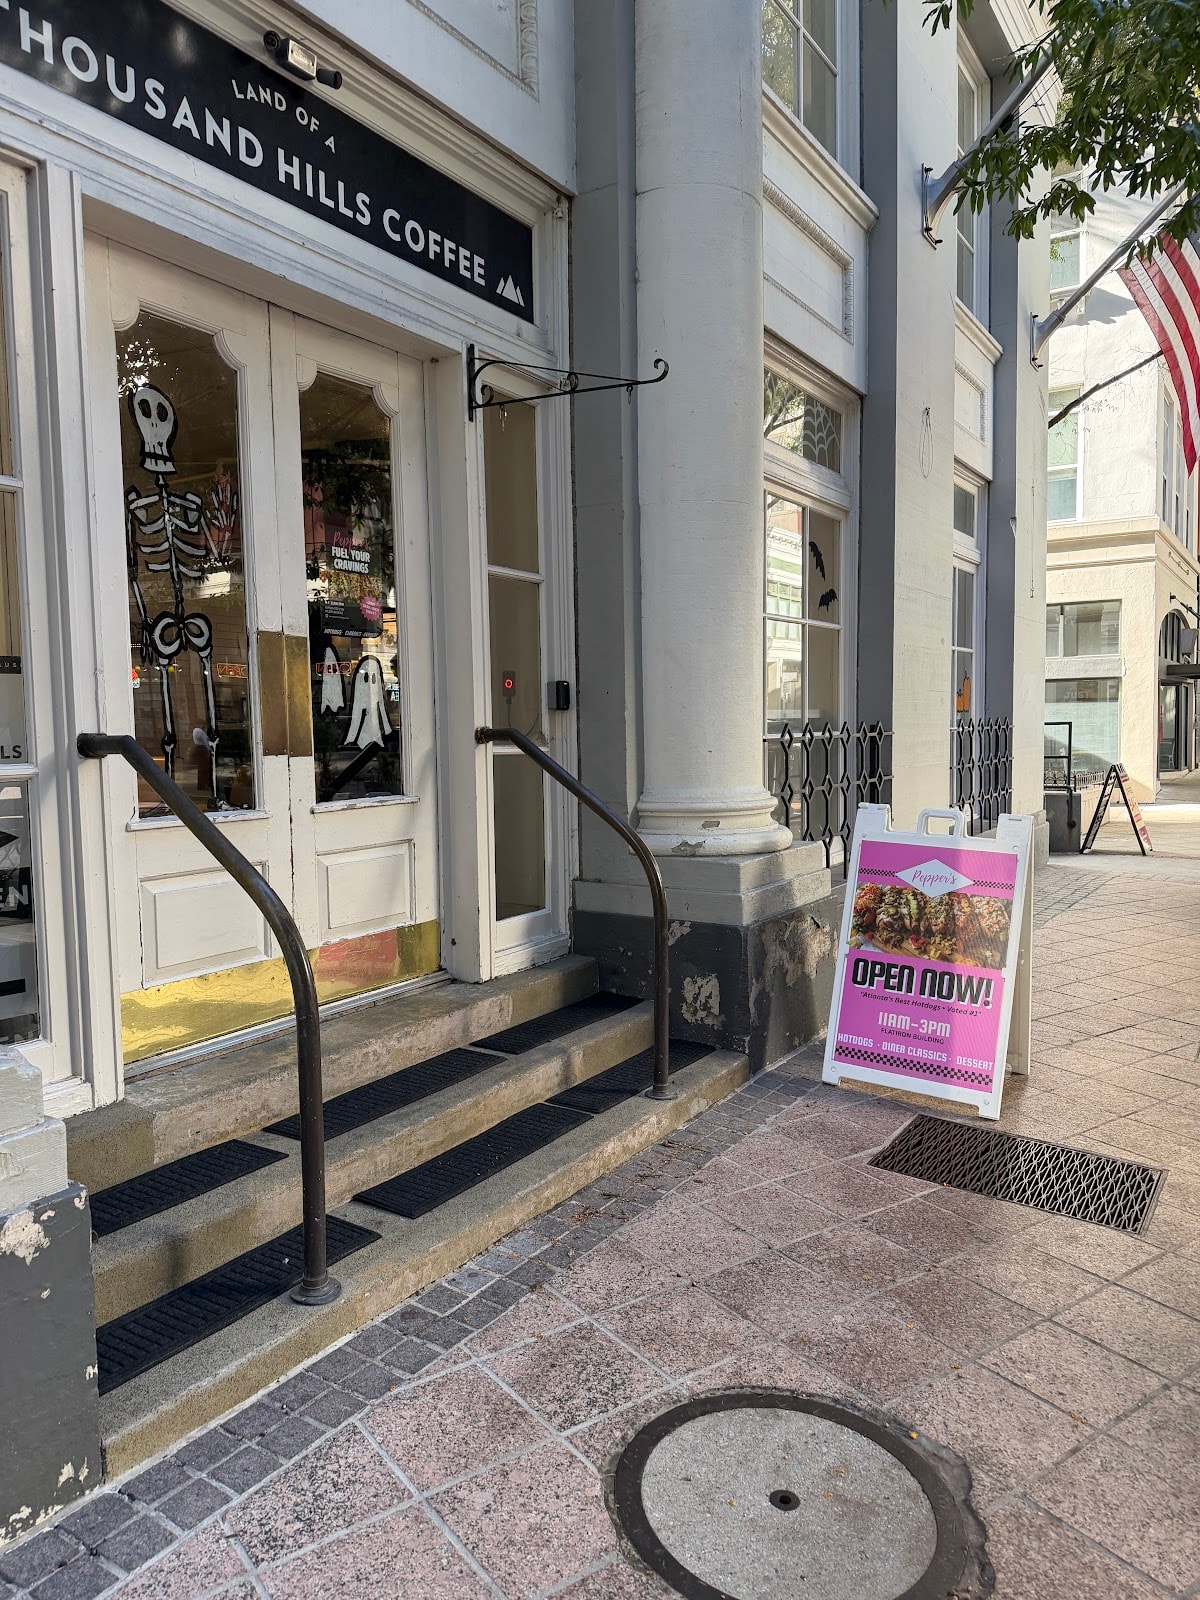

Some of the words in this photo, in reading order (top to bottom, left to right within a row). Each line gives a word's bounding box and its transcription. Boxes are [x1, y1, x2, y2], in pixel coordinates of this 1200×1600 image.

[231, 79, 287, 112] LAND
[295, 106, 320, 133] OF
[324, 135, 336, 154] A
[0, 0, 264, 168] HOUSAND
[277, 147, 372, 226] HILLS
[382, 208, 486, 287] COFFEE
[331, 545, 350, 559] FUEL
[350, 549, 371, 563] YOUR
[333, 558, 369, 574] CRAVINGS
[911, 869, 957, 887] Pepper's
[851, 957, 916, 997] OPEN
[918, 968, 994, 1009] NOW!
[894, 997, 911, 1007] Best
[911, 1000, 941, 1012] Hotdogs
[947, 1005, 968, 1016] Voted
[881, 1027, 912, 1039] FLATIRON
[912, 1033, 945, 1045] BUILDING
[837, 1032, 874, 1048] HOTDOGS
[881, 1041, 906, 1054] DINER
[907, 1046, 948, 1062] CLASSICS
[956, 1056, 994, 1071] DESSERT
